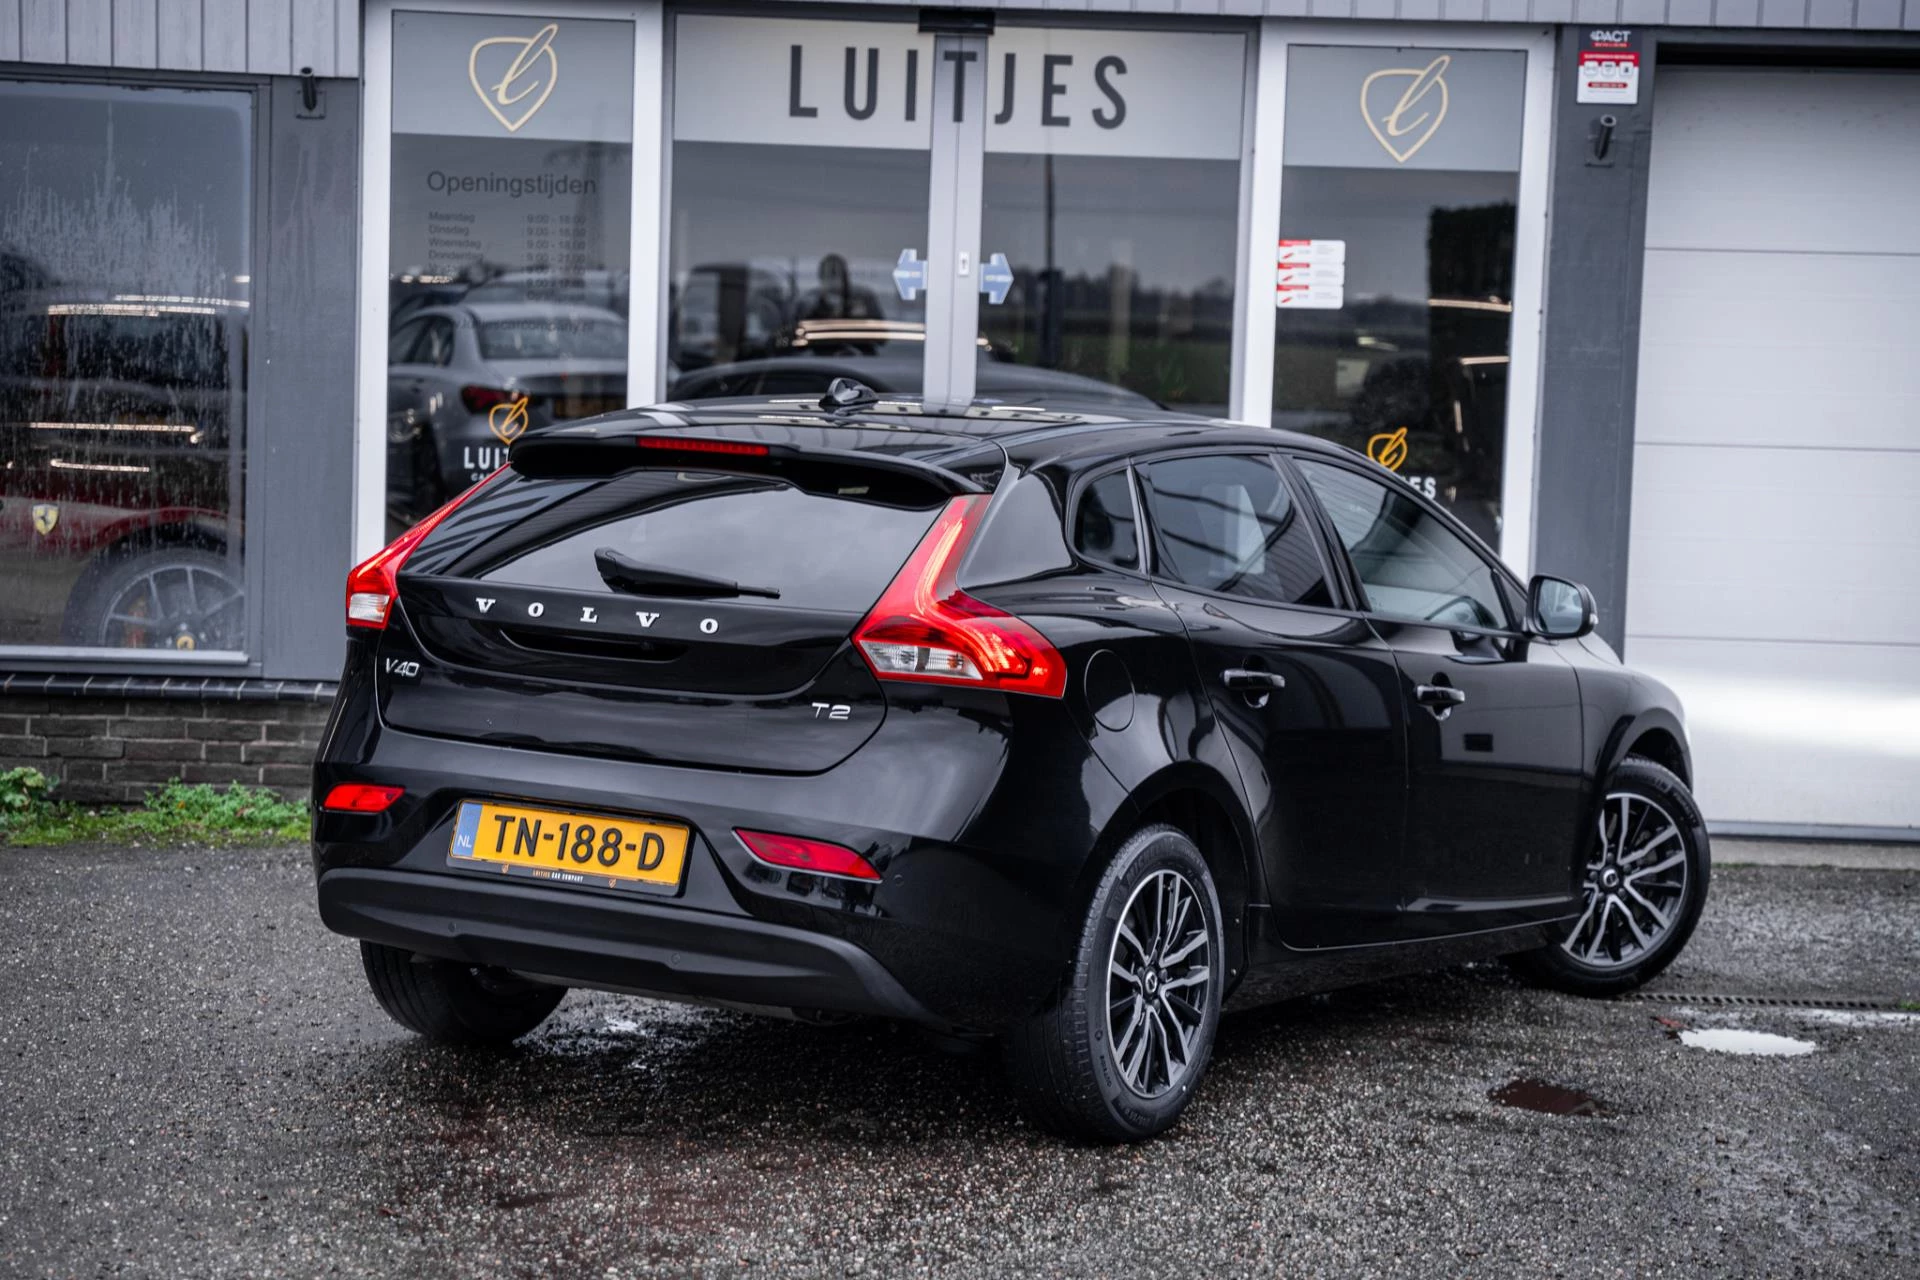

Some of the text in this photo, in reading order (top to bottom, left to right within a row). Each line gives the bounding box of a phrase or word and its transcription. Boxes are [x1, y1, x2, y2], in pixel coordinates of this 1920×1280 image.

[788, 45, 1128, 130] LUITJES
[427, 170, 597, 199] Openingstijden
[428, 211, 476, 224] Maandag
[475, 597, 719, 635] VOLVO
[385, 657, 420, 678] V40
[811, 702, 851, 720] T2
[456, 833, 472, 849] NL
[494, 814, 665, 871] TN-188-D
